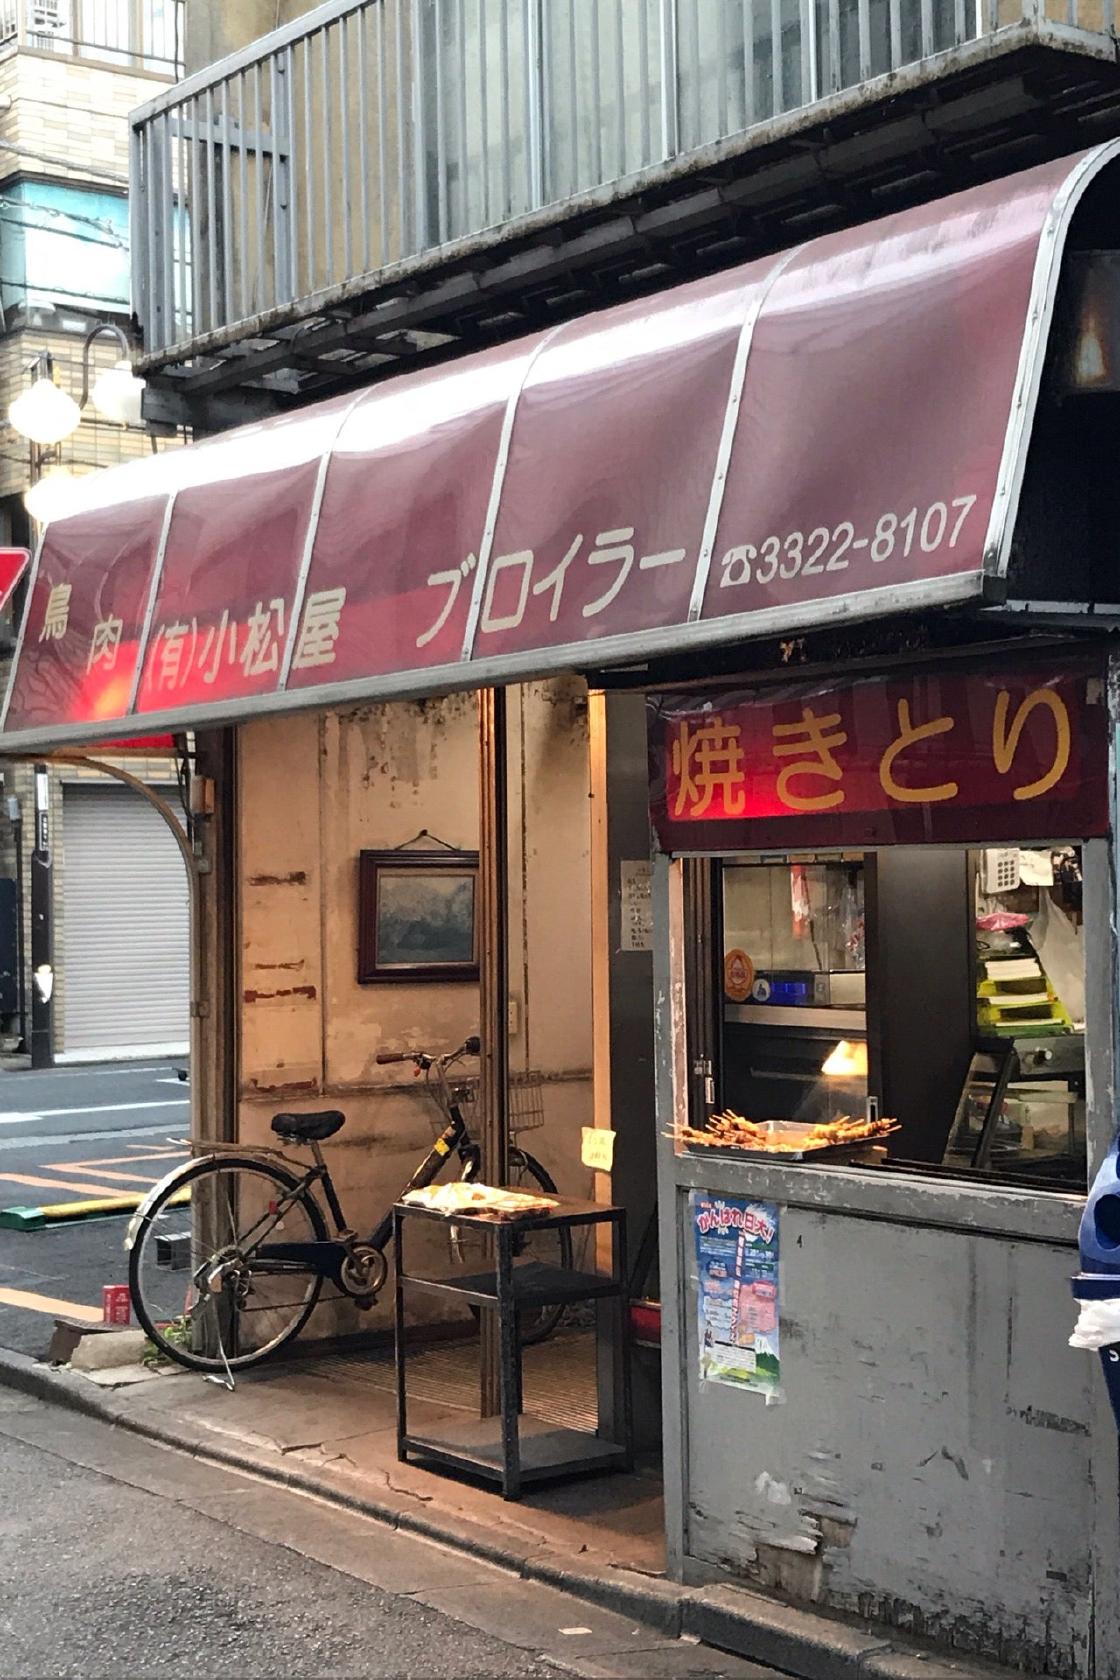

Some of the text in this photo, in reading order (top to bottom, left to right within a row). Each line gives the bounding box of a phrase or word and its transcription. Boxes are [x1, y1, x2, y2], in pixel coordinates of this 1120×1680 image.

[416, 526, 686, 648] ブロイラー
[672, 688, 1070, 817] 焼きとり
